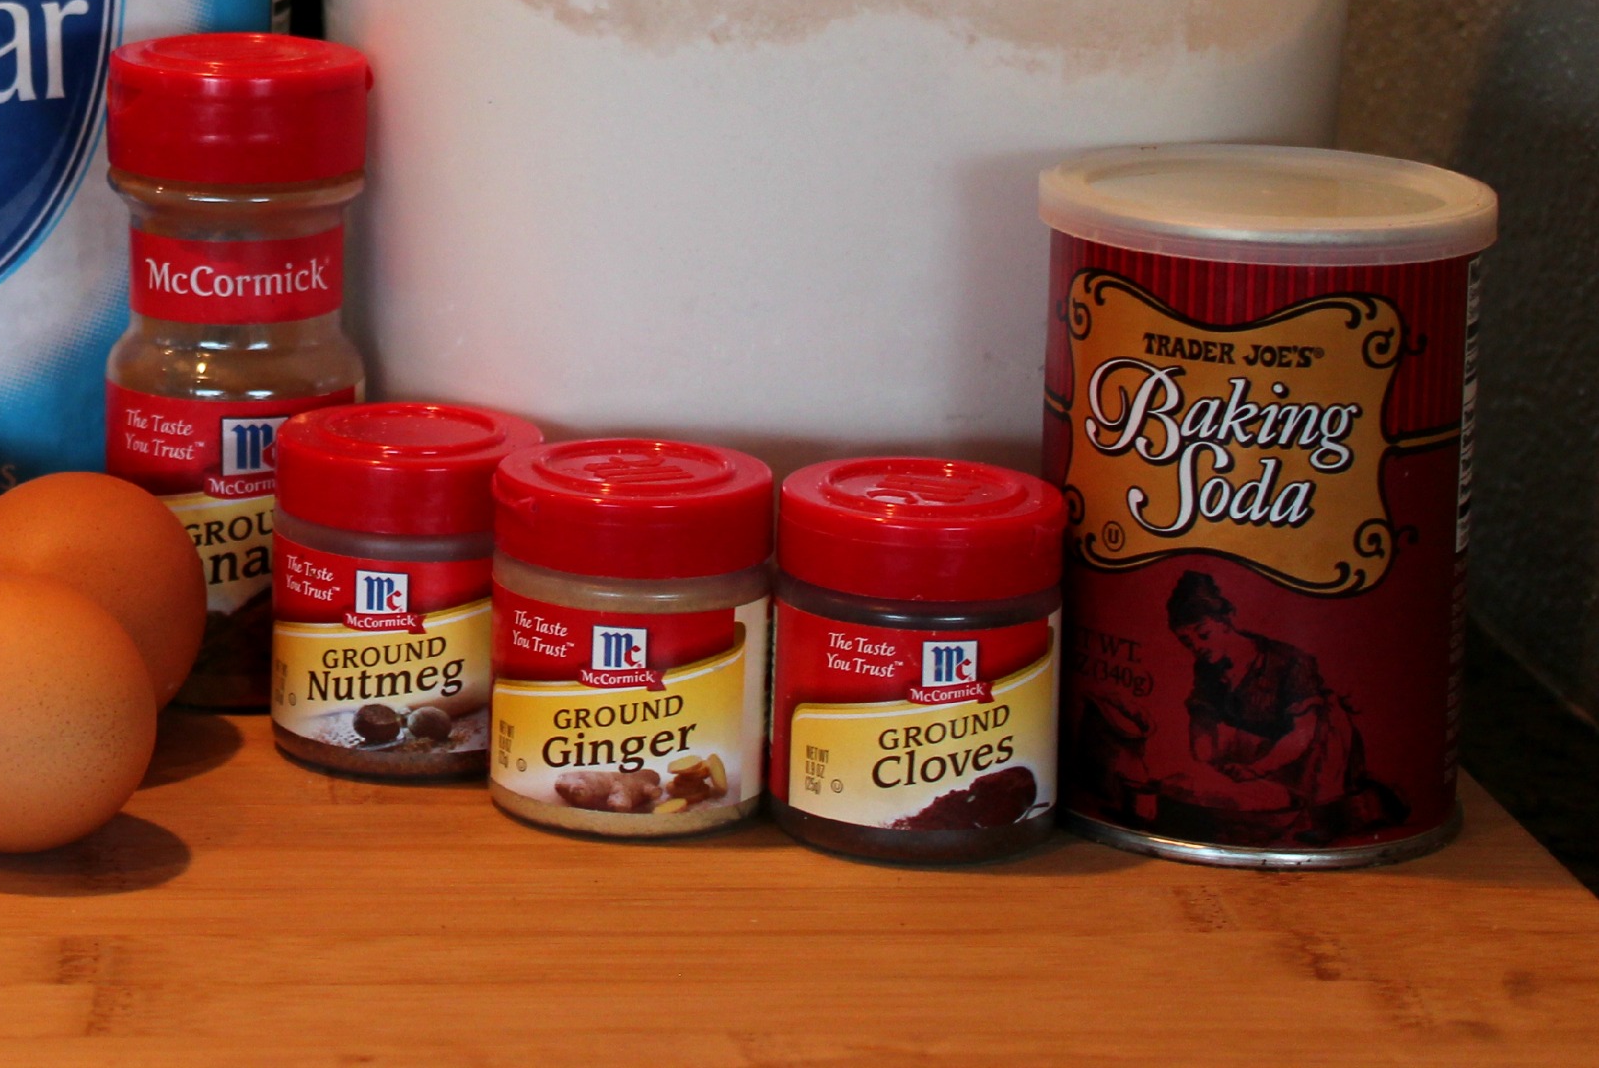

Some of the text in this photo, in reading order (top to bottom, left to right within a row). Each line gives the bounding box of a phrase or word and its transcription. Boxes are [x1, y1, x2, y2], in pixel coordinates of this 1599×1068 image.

[145, 257, 329, 297] McCormick
[1143, 332, 1236, 364] TRADER
[126, 408, 193, 436] The Taste
[1085, 356, 1362, 472] Baking
[125, 432, 149, 453] You
[209, 478, 276, 496] McCorm
[1126, 440, 1314, 536] Soda
[286, 554, 303, 573] The
[286, 573, 302, 592] You
[346, 613, 417, 629] McCormick
[514, 609, 568, 637] The Taste
[322, 636, 447, 669] GROUND
[512, 629, 530, 650] You
[828, 632, 896, 658] The Taste
[826, 652, 851, 672] You
[307, 658, 465, 701] Nutmeg
[580, 669, 656, 686] McCormick
[910, 684, 985, 703] McCormick
[553, 694, 684, 730] GROUND
[878, 704, 1011, 751] GROUND
[542, 722, 697, 774] Ginger
[871, 734, 1015, 790] Cloves
